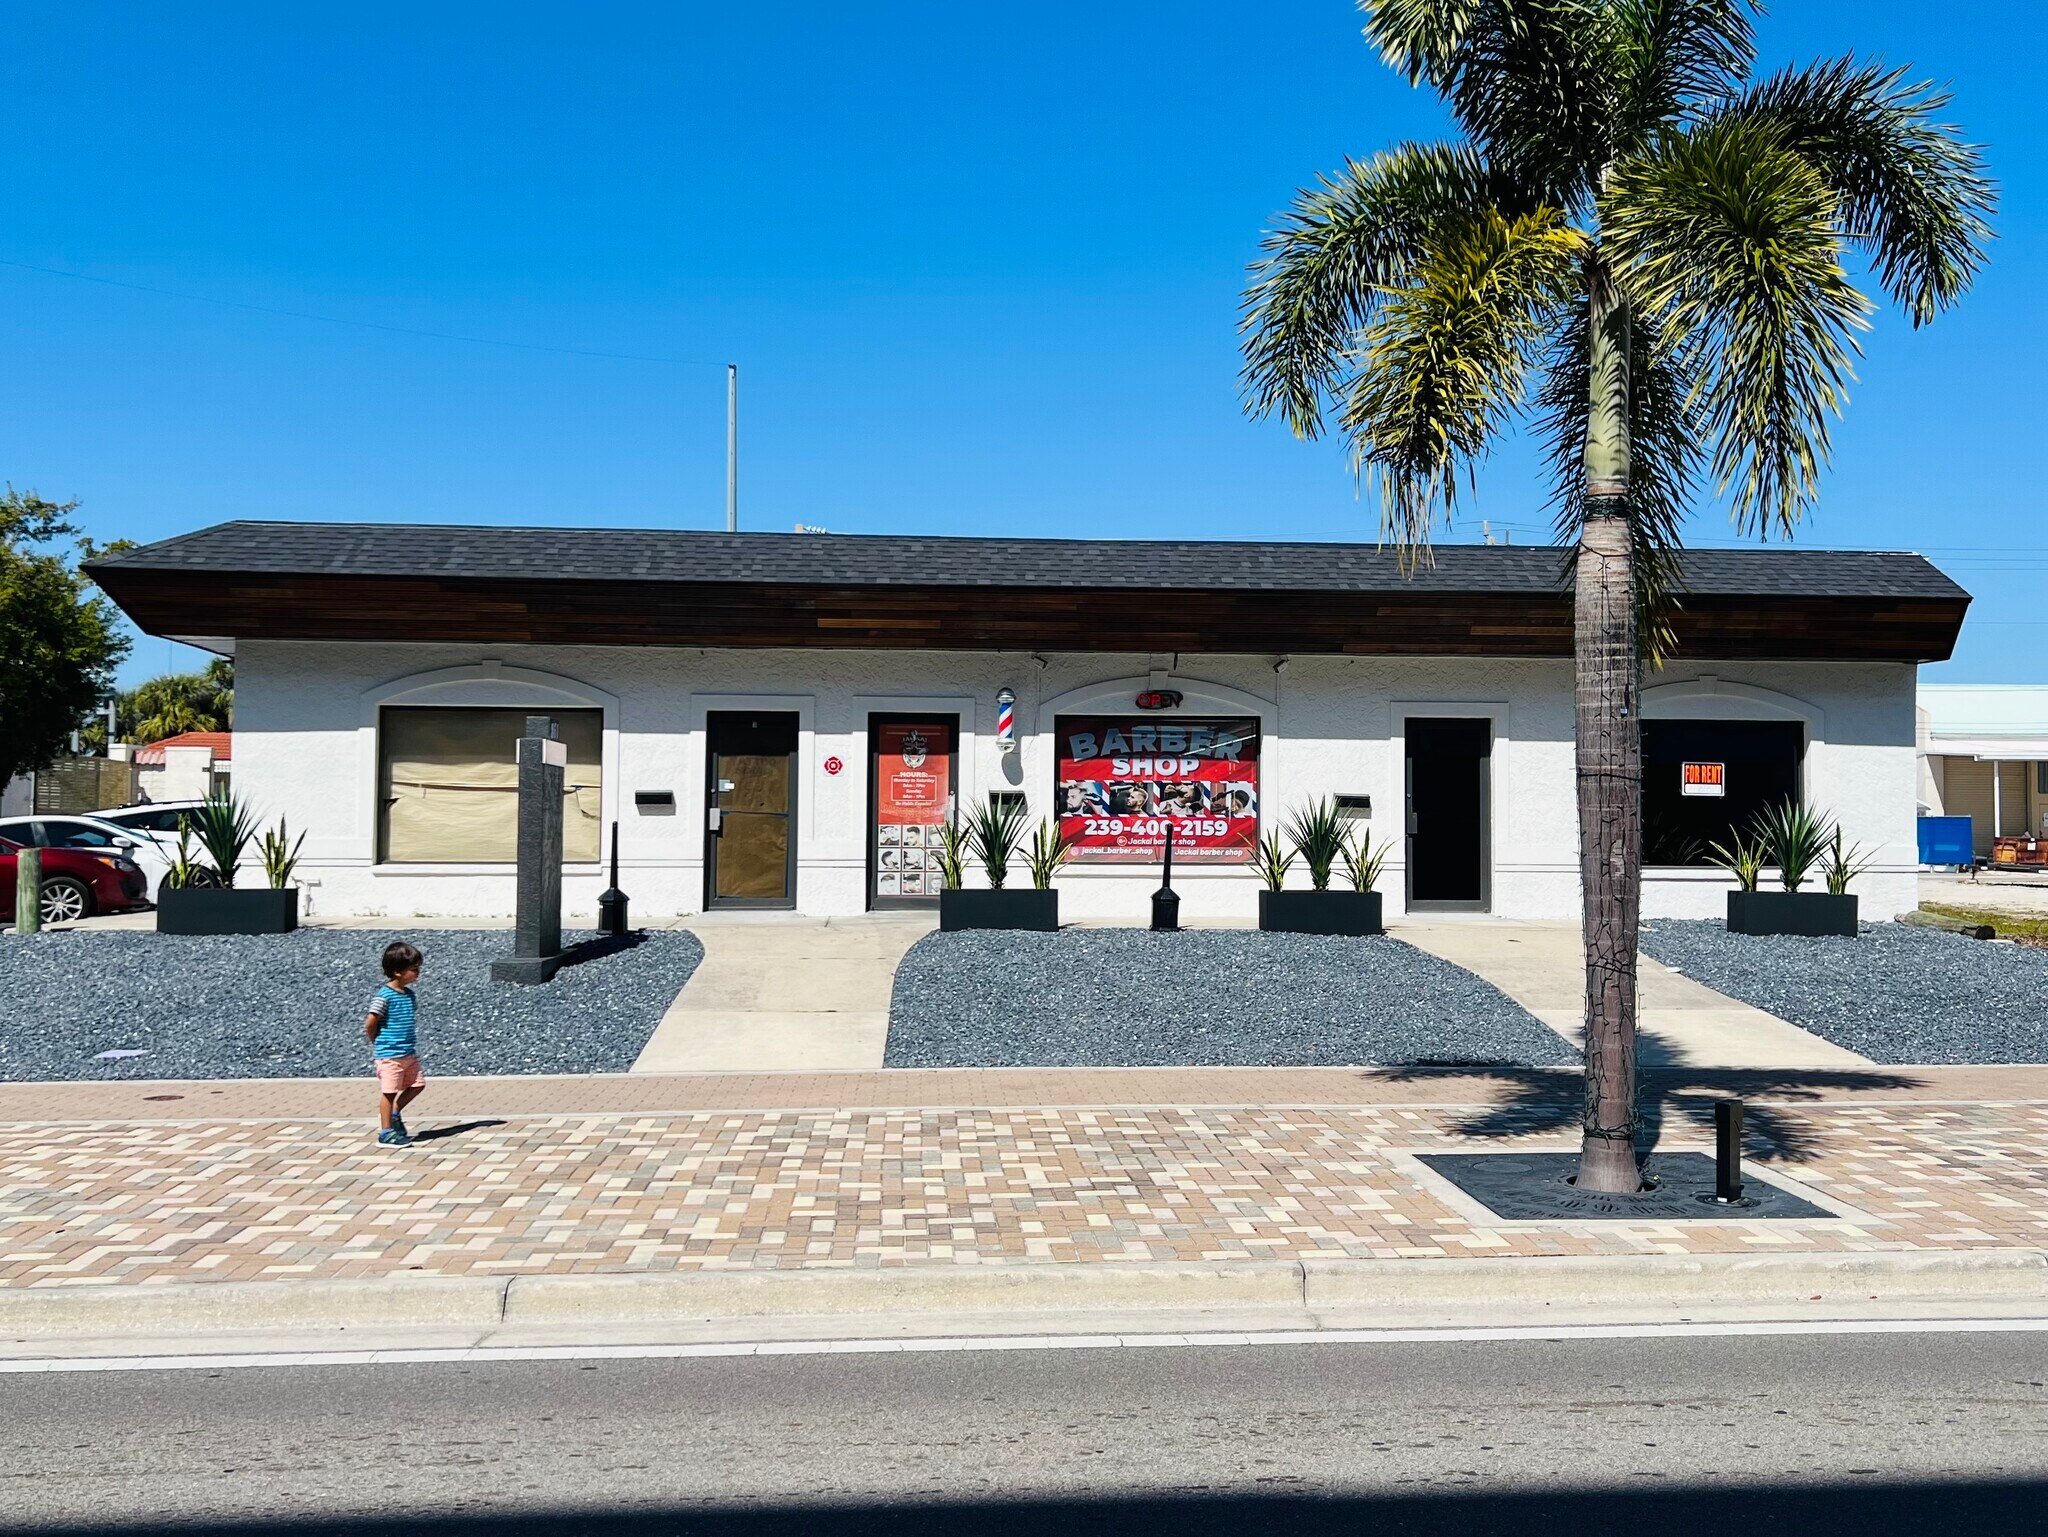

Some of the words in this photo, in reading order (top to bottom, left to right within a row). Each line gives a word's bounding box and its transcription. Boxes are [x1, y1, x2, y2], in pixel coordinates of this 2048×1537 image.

[1138, 691, 1182, 709] OPEN
[1068, 725, 1243, 763] BARBER
[1111, 756, 1200, 777] SHOP
[1685, 764, 1700, 783] FOR
[1701, 764, 1722, 784] RENT
[1081, 846, 1154, 856] jackal_barber_shop
[1127, 837, 1153, 845] Jackal
[1178, 838, 1197, 847] shop
[1174, 848, 1199, 856] Jackal
[1199, 848, 1224, 856] barber
[1225, 848, 1243, 857] shop
